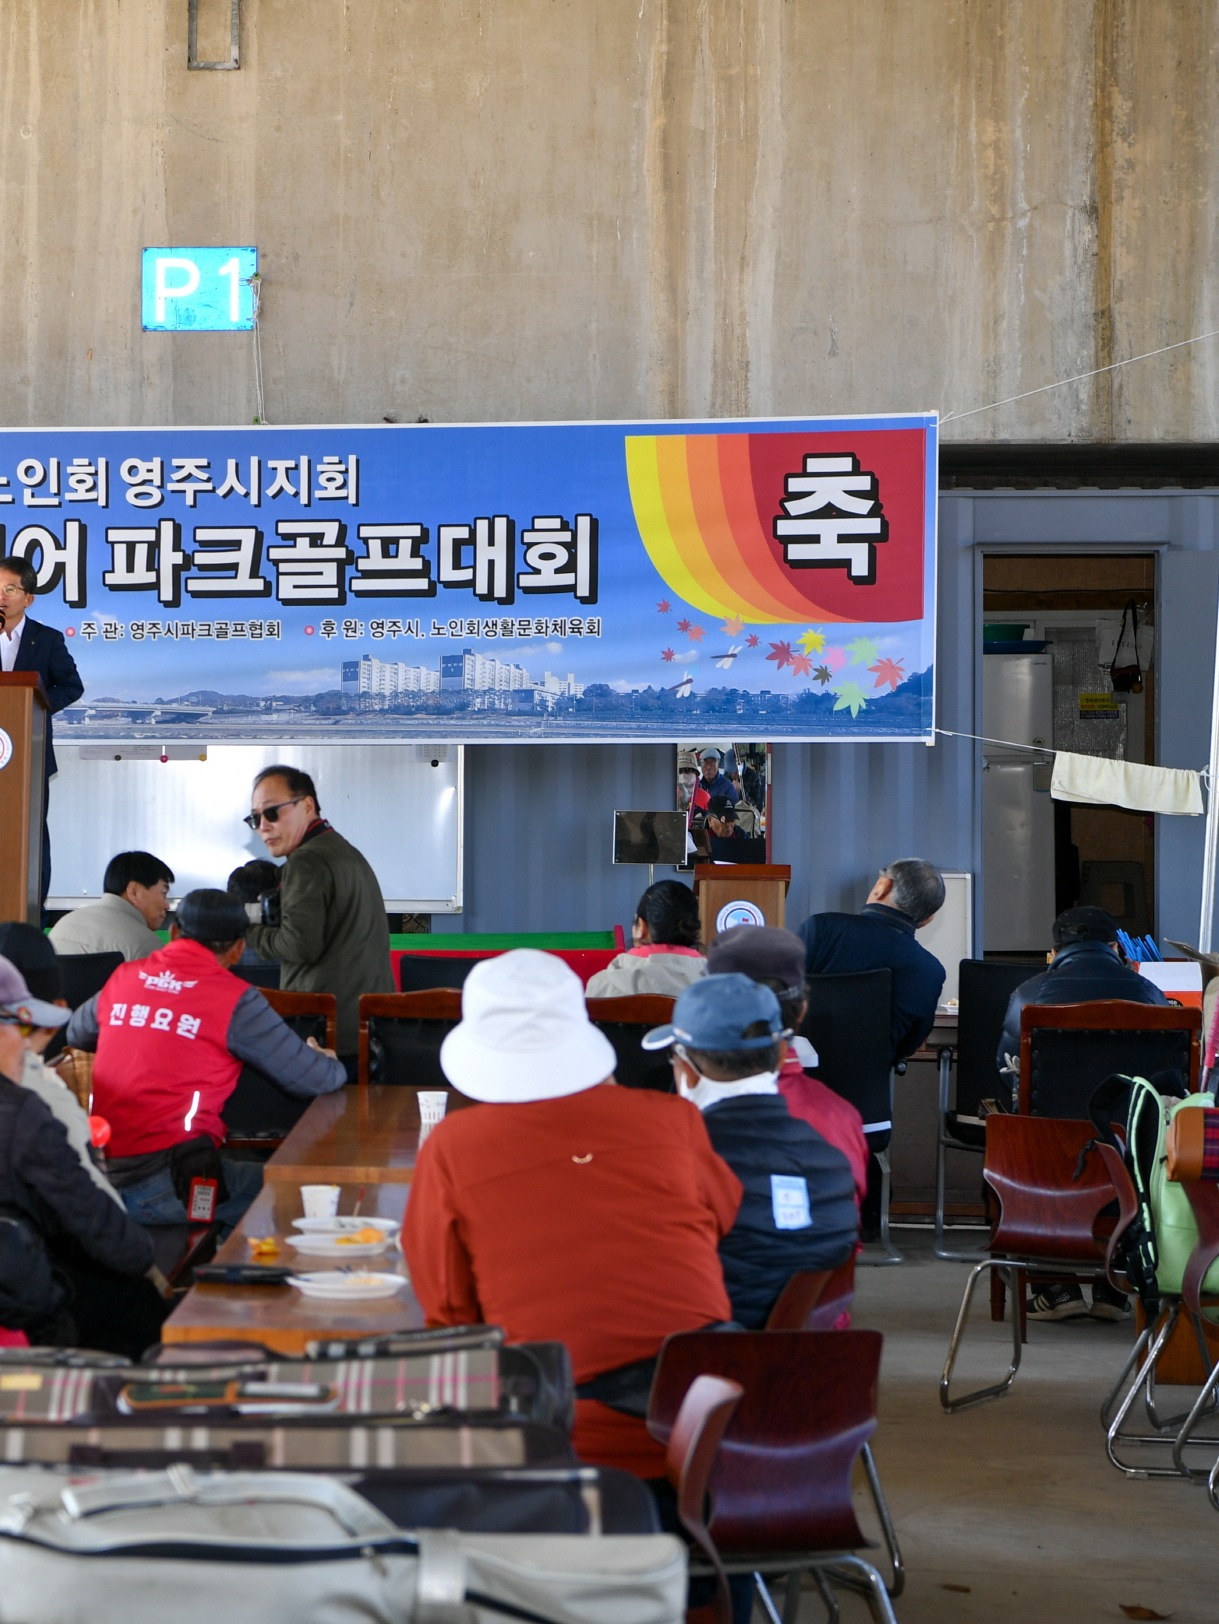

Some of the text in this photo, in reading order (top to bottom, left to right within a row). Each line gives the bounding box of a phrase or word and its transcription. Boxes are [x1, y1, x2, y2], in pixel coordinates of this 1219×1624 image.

[119, 454, 359, 507] 영주시지회
[773, 452, 889, 586] 축
[103, 513, 598, 607] 파크골프대회
[81, 620, 281, 640] 주 관: 영주시파크골프협회
[320, 619, 337, 639] 후
[342, 619, 364, 638] 원:
[430, 616, 602, 638] 노인회생활문화체육회
[109, 1003, 202, 1040] 진행요원
